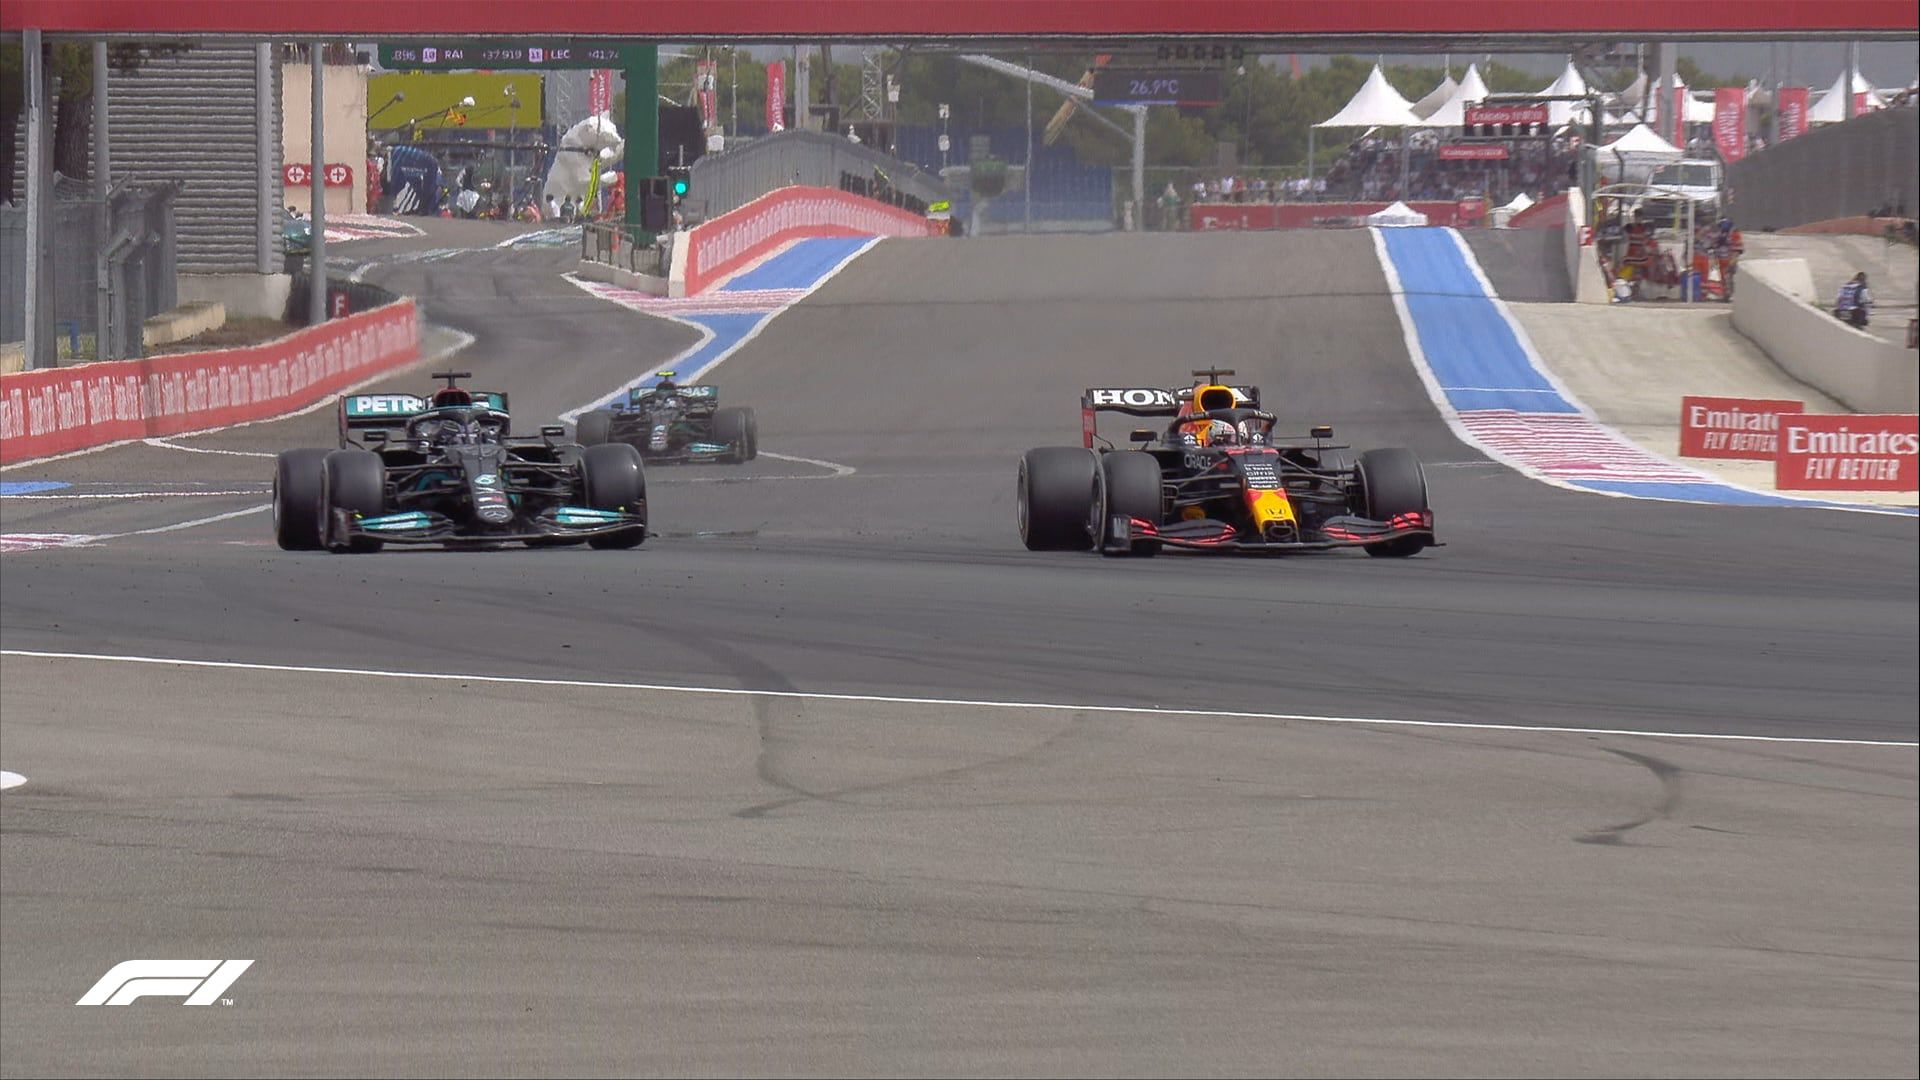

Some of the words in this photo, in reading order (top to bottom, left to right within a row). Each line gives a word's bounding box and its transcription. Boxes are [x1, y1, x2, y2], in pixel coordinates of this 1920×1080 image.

[445, 49, 463, 60] RAI
[551, 49, 570, 59] LEC
[335, 295, 345, 316] F
[1690, 406, 1779, 431] Emirat
[1703, 431, 1729, 450] FLY
[1787, 426, 1919, 455] Emirates
[1804, 457, 1837, 480] FLY
[1837, 457, 1900, 481] BETTER
